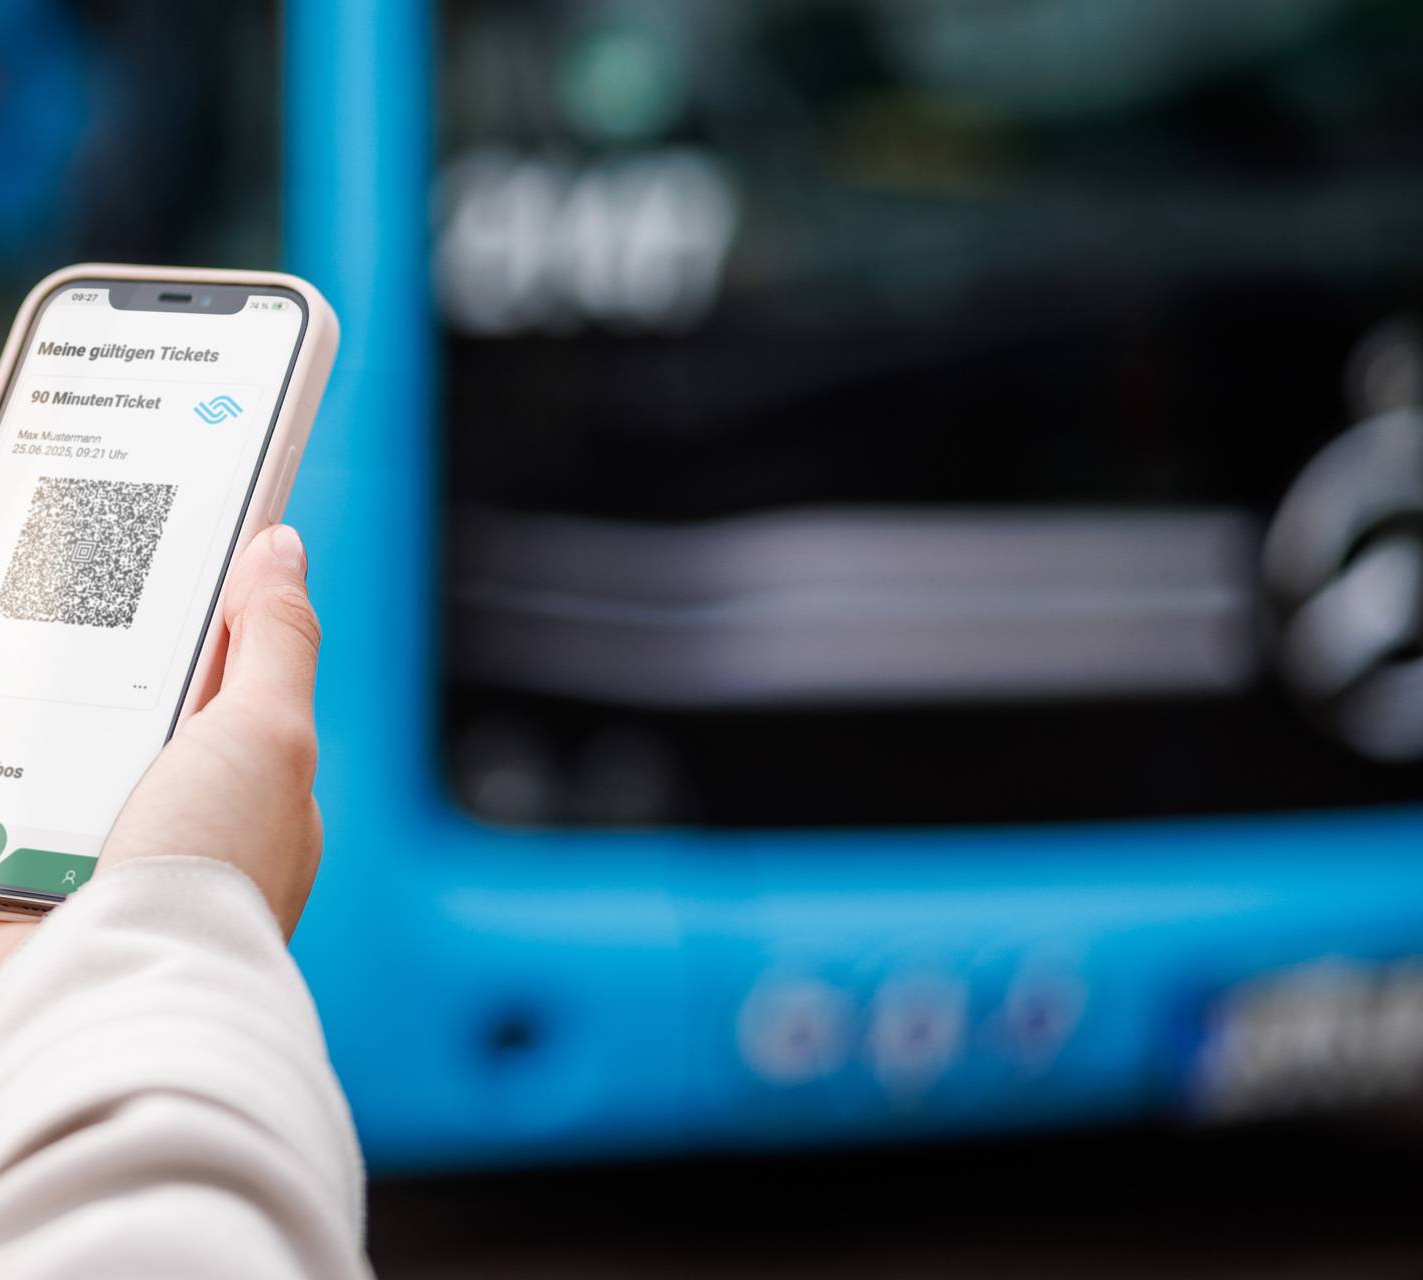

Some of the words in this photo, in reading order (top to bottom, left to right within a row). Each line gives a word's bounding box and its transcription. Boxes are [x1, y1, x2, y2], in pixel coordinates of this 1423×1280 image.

[37, 342, 86, 357] Meine
[89, 343, 155, 361] gültigen
[160, 346, 220, 363] Tickets
[31, 390, 50, 404] 90
[52, 390, 162, 410] MinutenTicket
[17, 430, 39, 441] Max
[41, 431, 102, 443] Mustermann
[12, 443, 74, 458] 25.06.2025,
[109, 449, 129, 460] Uhr
